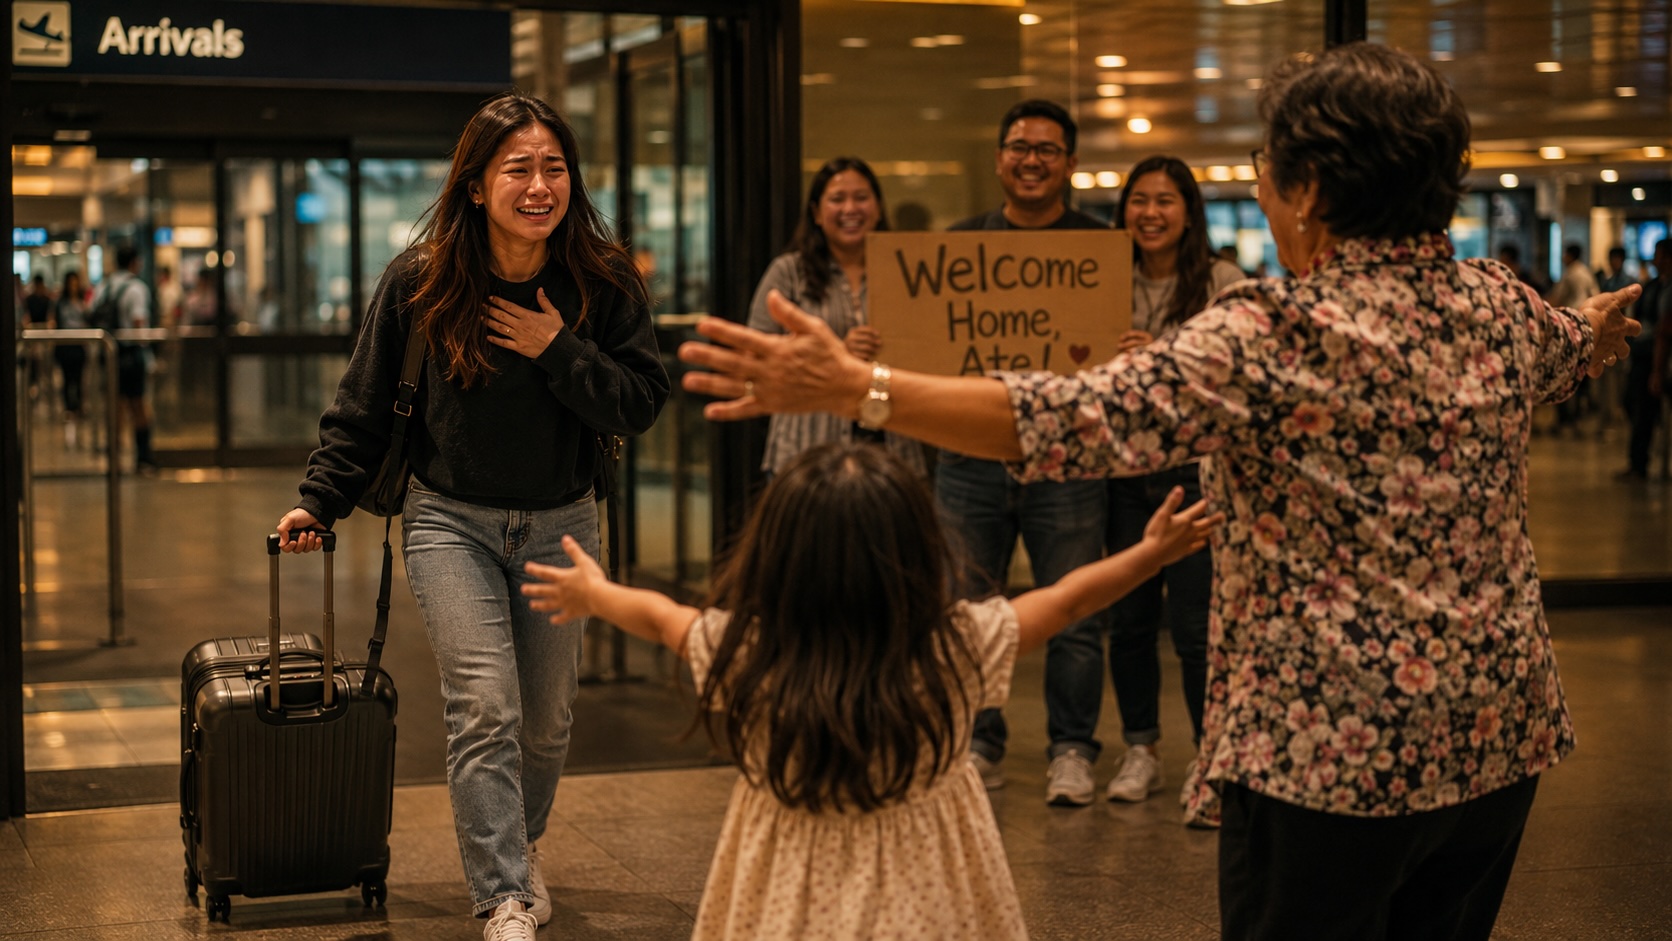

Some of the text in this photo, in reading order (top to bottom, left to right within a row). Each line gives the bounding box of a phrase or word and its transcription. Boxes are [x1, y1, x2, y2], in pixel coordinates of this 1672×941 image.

[98, 17, 244, 59] Arrivals
[895, 244, 1099, 298] Welcome
[948, 301, 1060, 341] Home,
[960, 344, 1051, 376] Ate!
